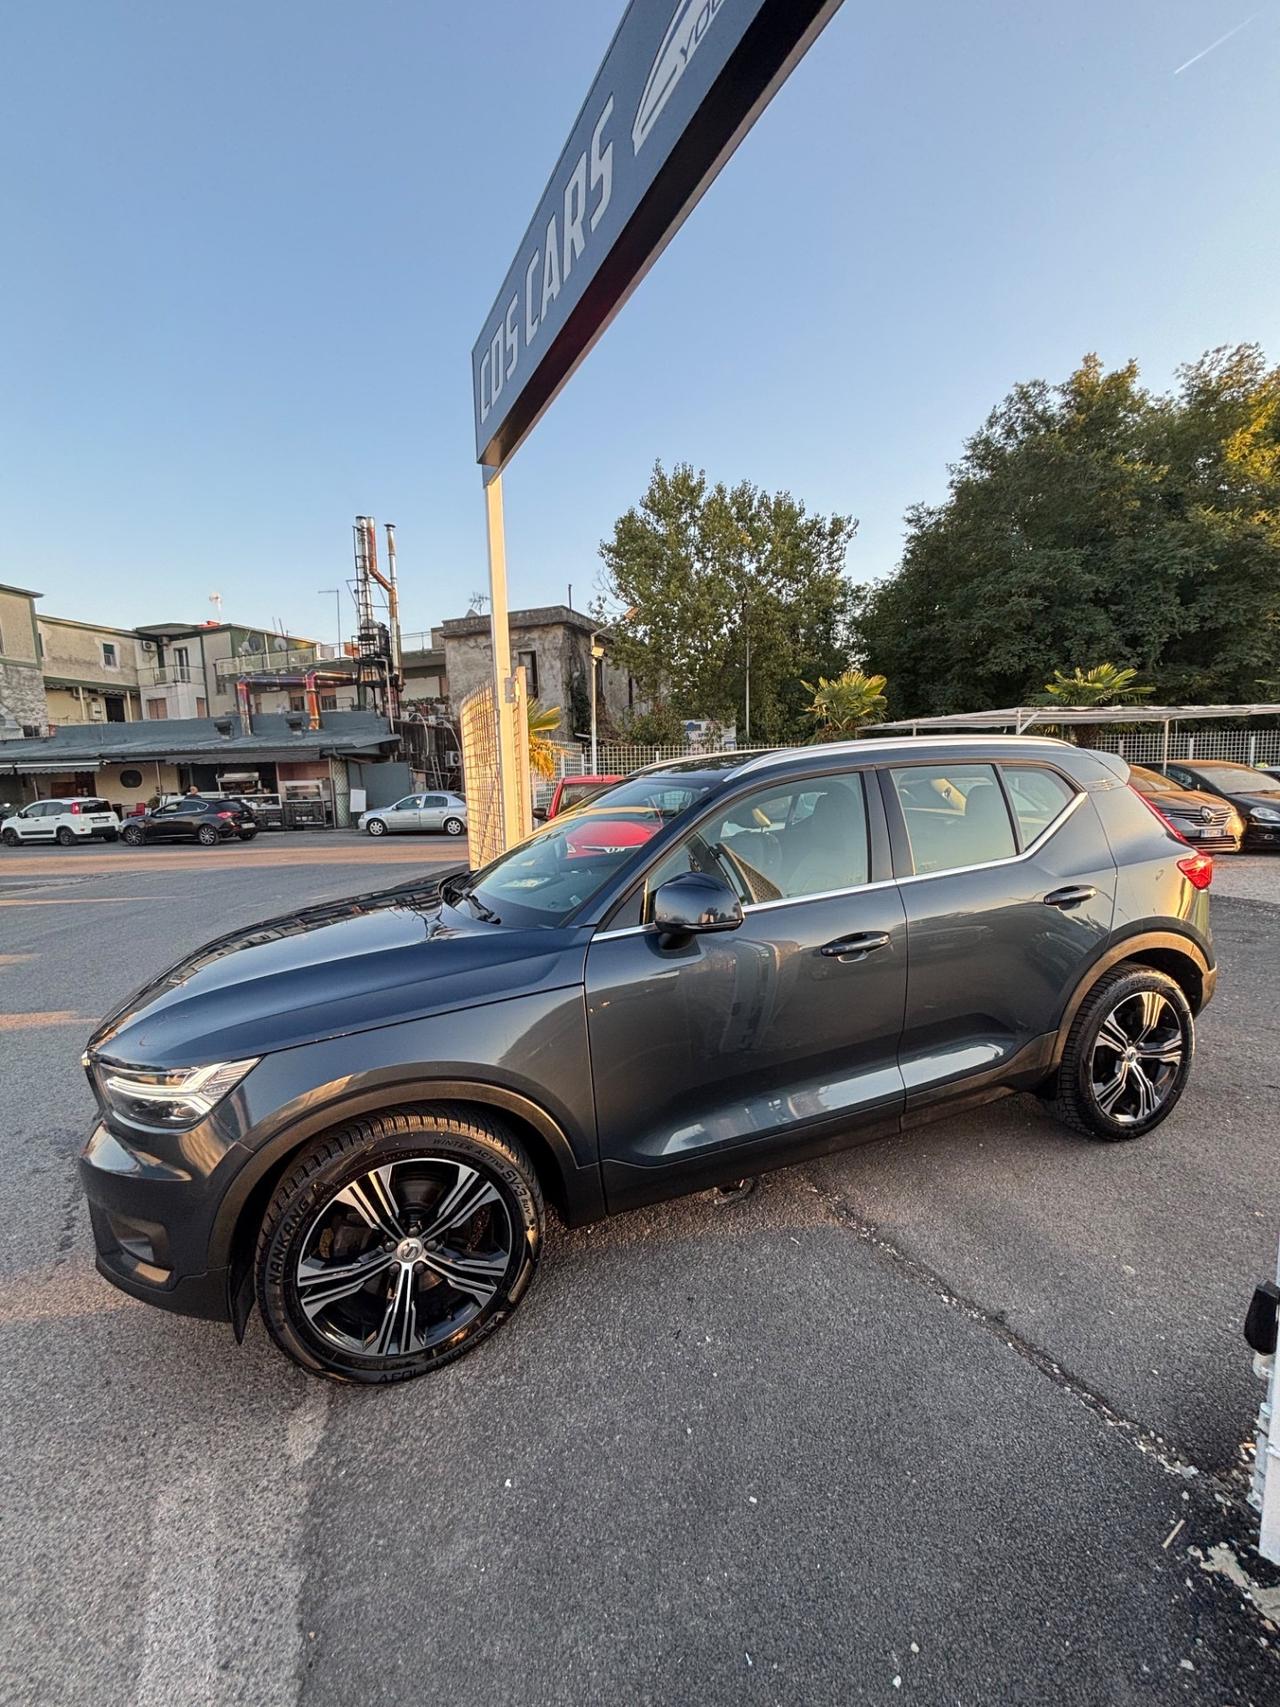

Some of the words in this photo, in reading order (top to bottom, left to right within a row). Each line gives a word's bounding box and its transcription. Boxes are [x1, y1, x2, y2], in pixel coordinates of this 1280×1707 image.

[480, 291, 518, 424] COS
[525, 92, 614, 346] CARS
[433, 1138, 473, 1151] WINTER
[475, 1149, 505, 1171] ACTIVA
[502, 1169, 528, 1198] SV-3
[522, 1198, 533, 1216] SUV
[269, 1196, 311, 1286] NANKANG
